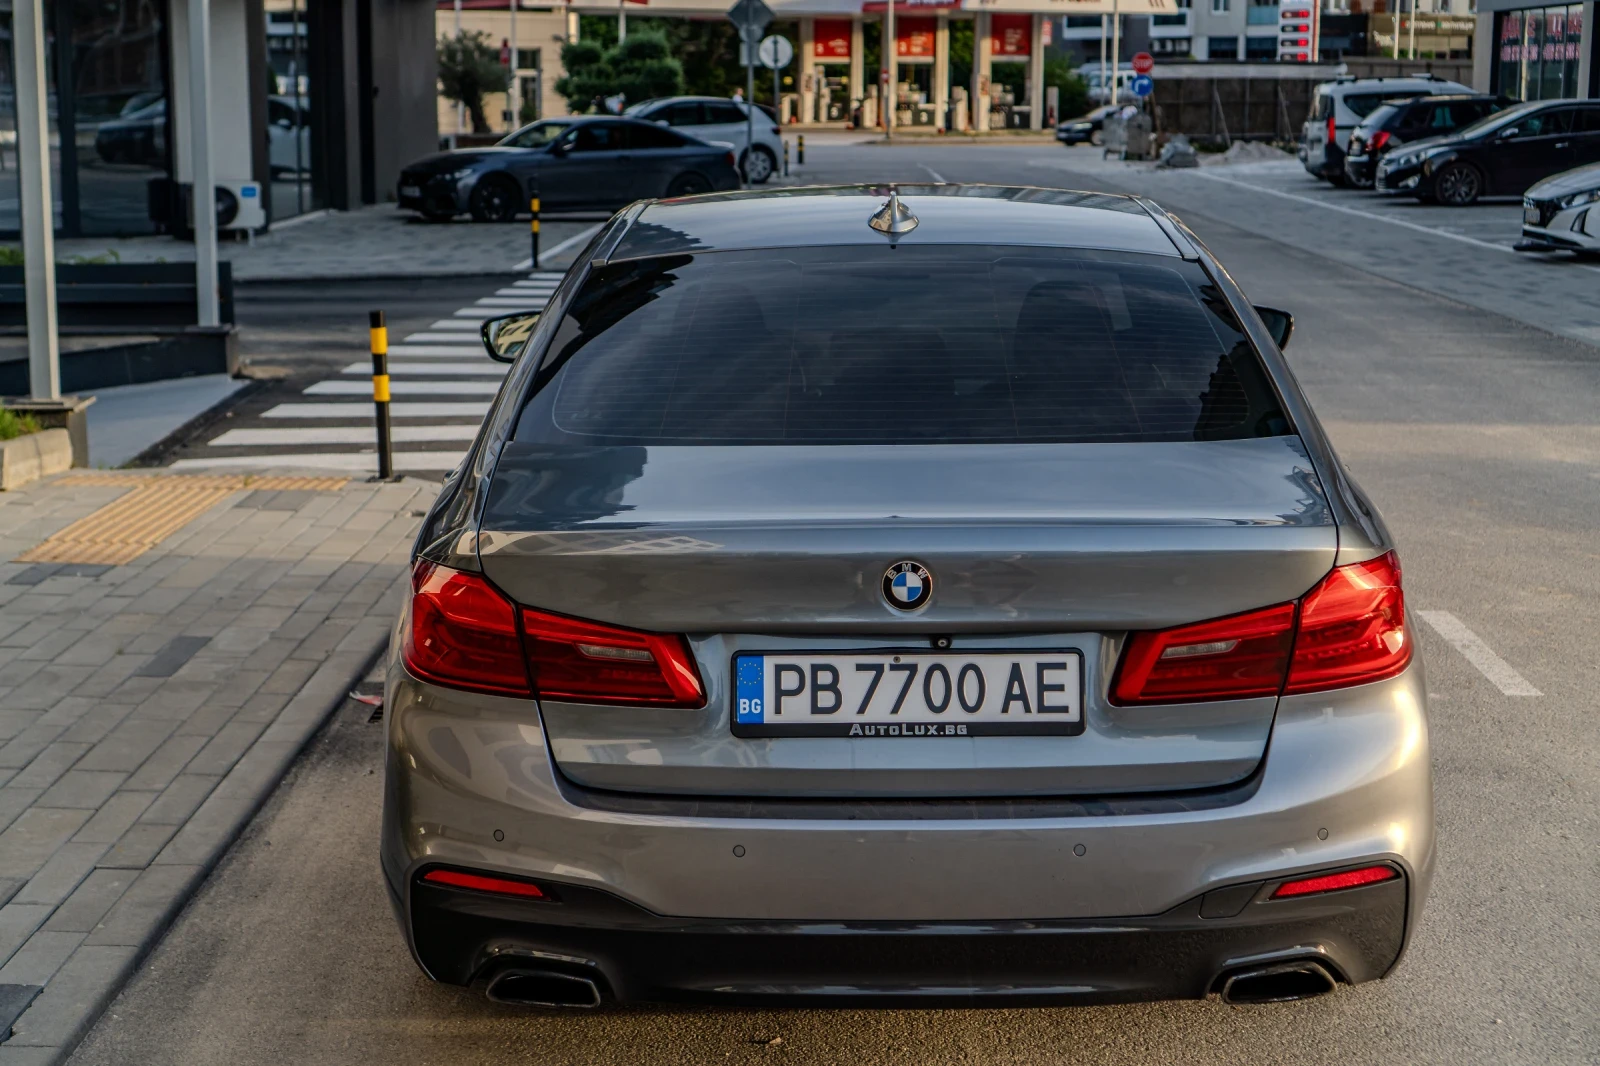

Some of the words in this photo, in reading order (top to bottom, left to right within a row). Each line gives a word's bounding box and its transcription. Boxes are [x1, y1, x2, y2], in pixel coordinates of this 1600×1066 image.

[1134, 59, 1153, 69] STOP
[886, 563, 929, 580] BMW
[739, 698, 762, 715] BG
[773, 663, 843, 715] PB
[855, 662, 986, 715] 7700
[1000, 662, 1070, 714] AE
